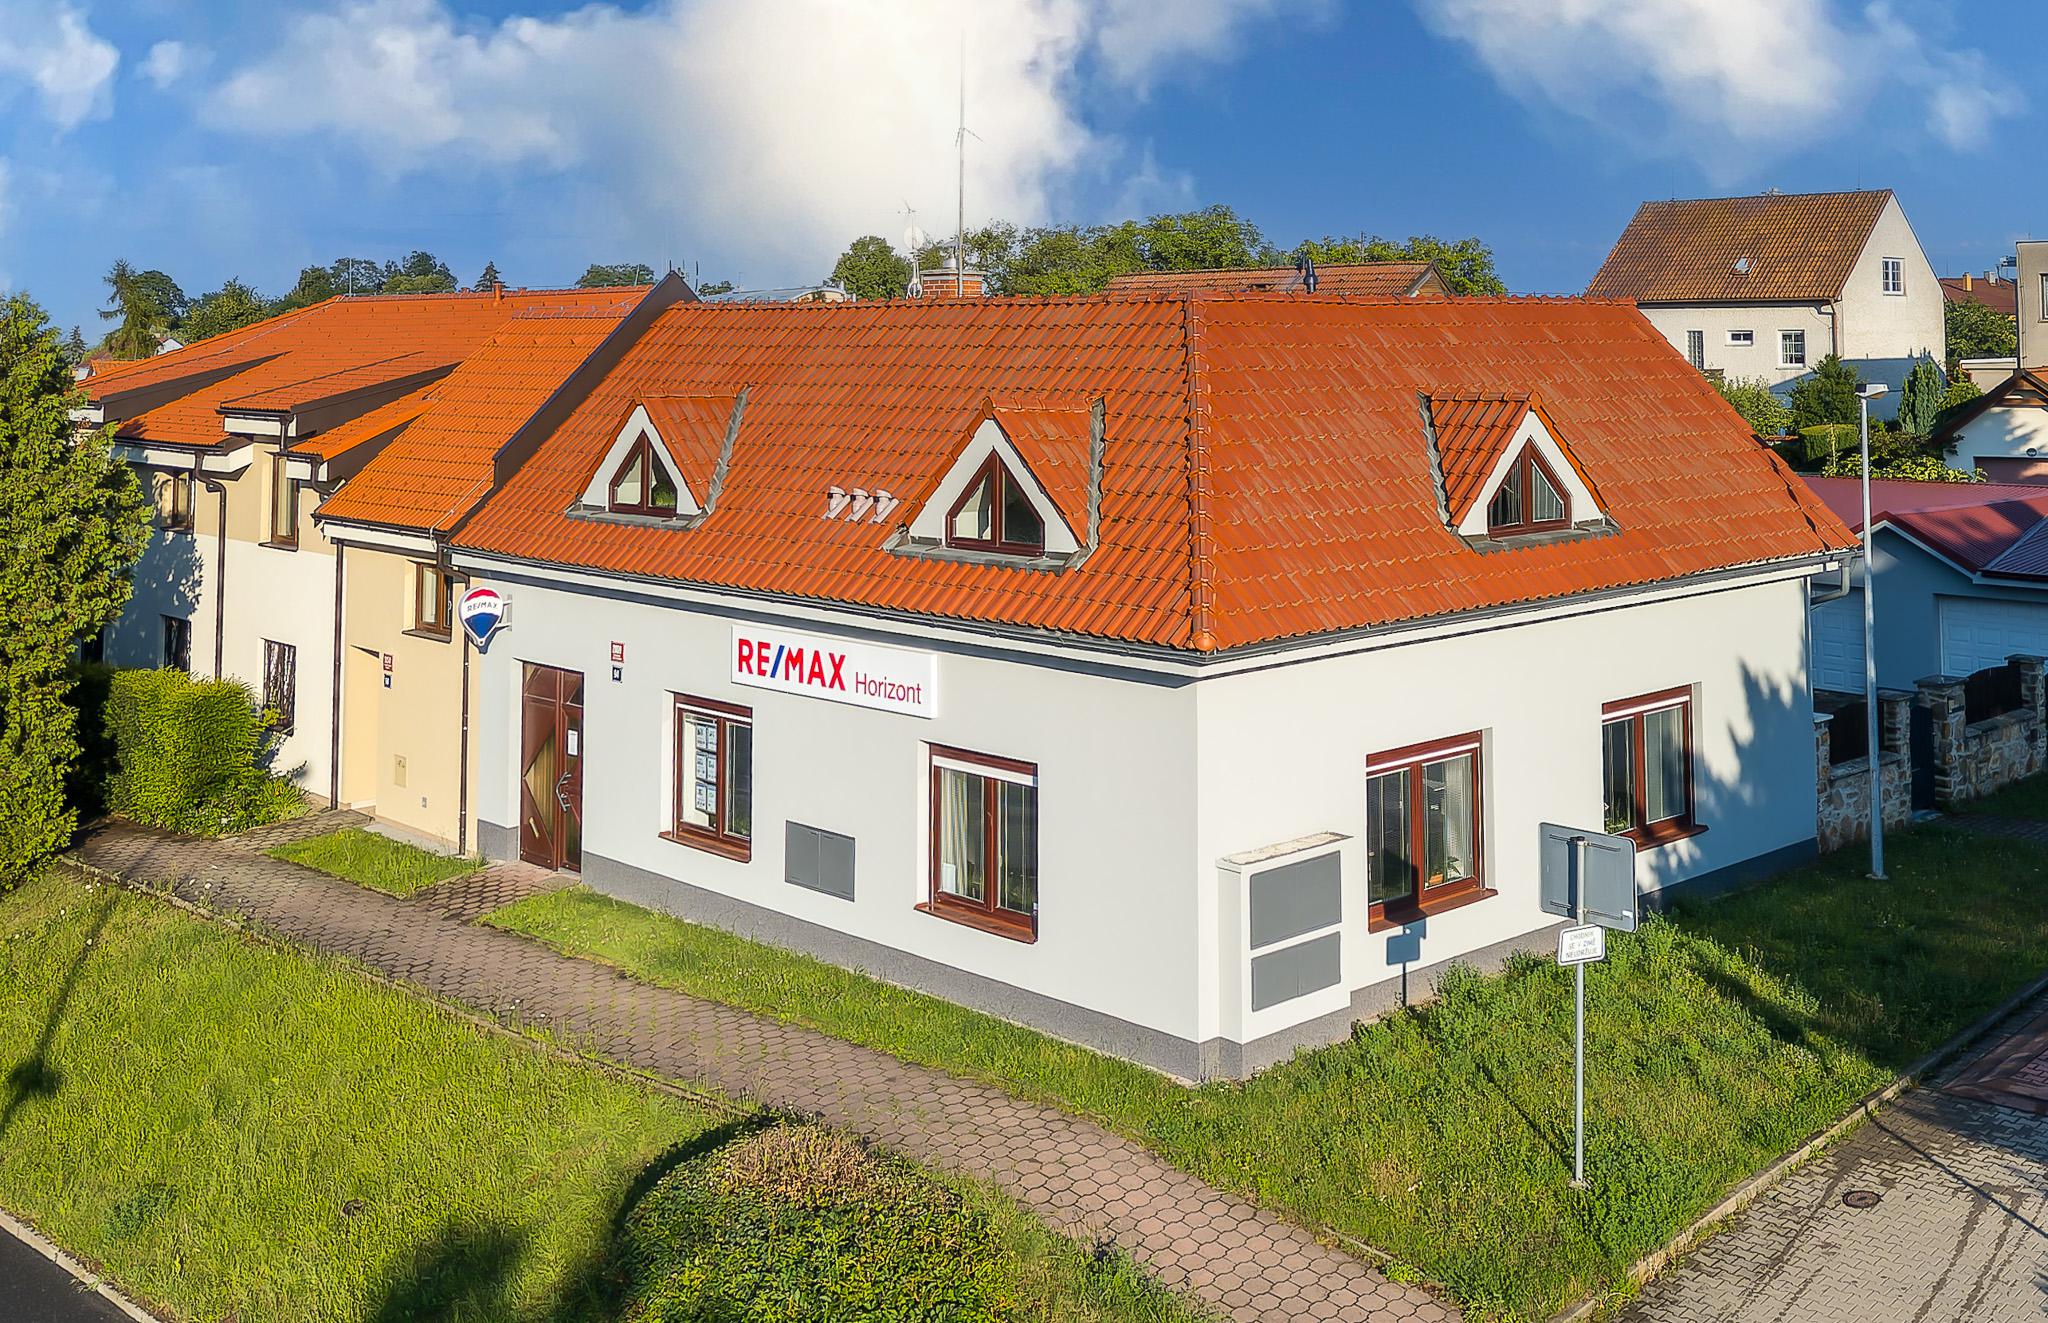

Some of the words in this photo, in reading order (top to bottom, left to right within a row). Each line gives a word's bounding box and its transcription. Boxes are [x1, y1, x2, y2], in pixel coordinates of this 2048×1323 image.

[467, 601, 497, 611] RE/MAX
[738, 638, 846, 691] RE/MAX
[855, 671, 921, 704] Horizont
